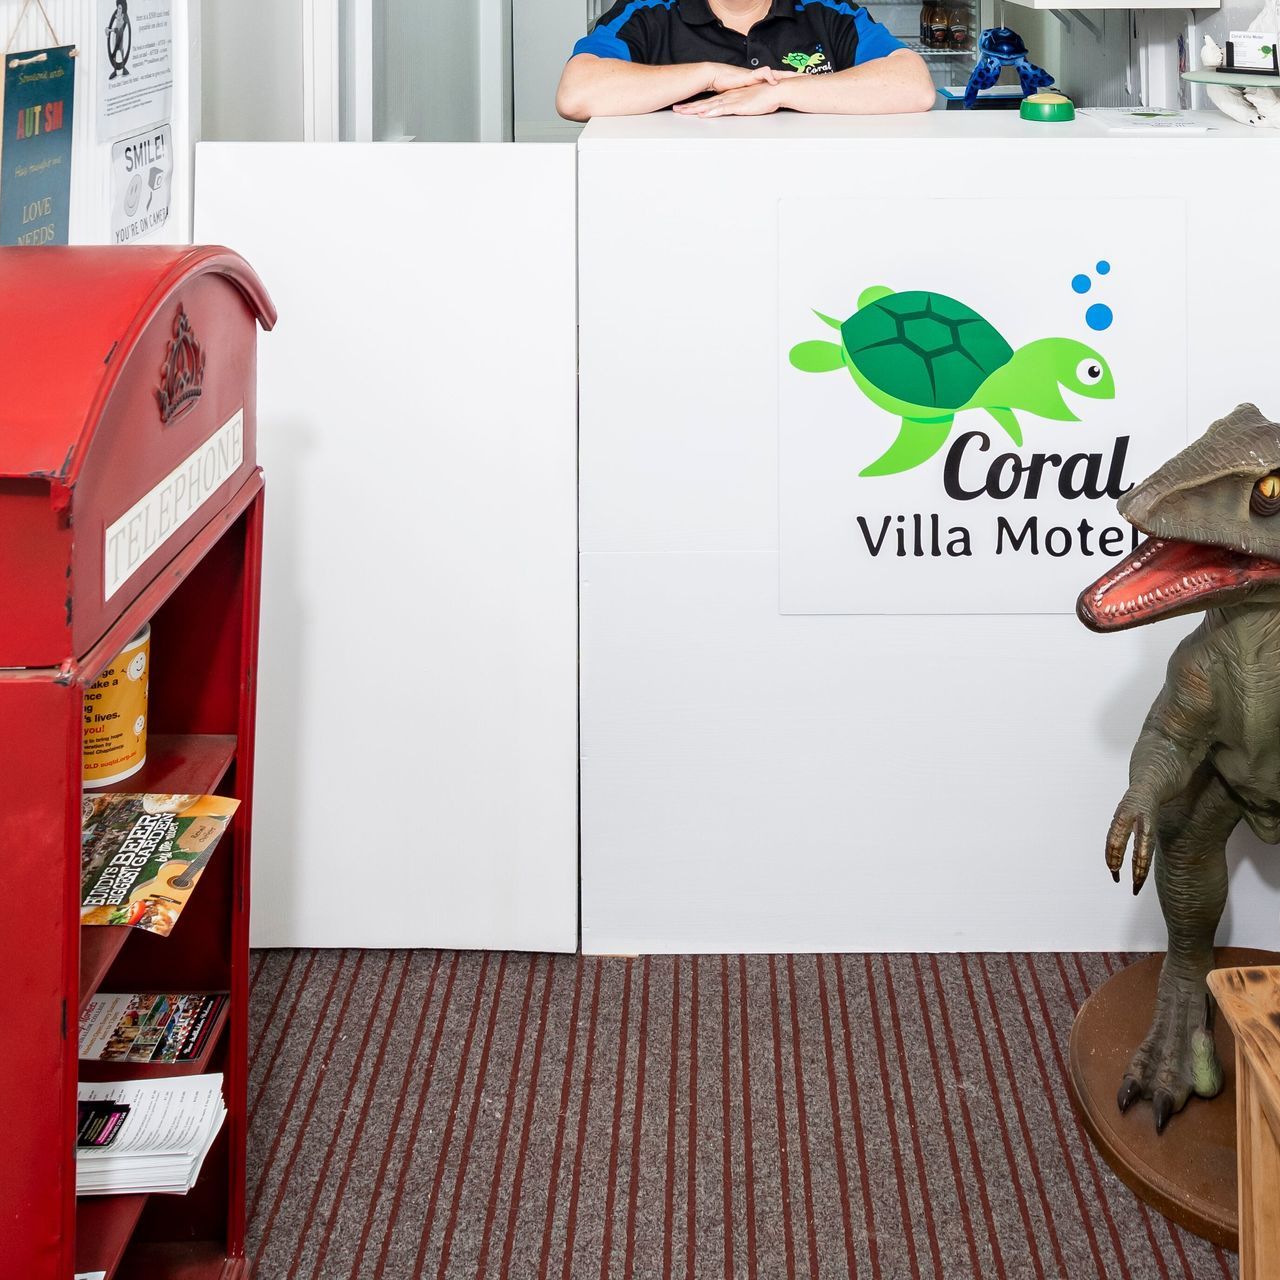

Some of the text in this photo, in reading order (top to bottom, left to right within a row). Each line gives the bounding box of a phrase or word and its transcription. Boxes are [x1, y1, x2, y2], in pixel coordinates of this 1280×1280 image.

[805, 61, 832, 74] Coral
[124, 133, 165, 173] SMILE!
[22, 196, 53, 225] LOVE
[16, 223, 55, 246] NEEDS
[115, 221, 140, 244] YOU'RE
[140, 218, 149, 232] ON
[943, 430, 1135, 501] Coral
[107, 419, 242, 586] TELEPHONE
[856, 513, 1142, 558] Villa Motel
[83, 724, 106, 736] you!
[94, 712, 121, 724] lives.
[110, 812, 163, 866] BEER
[131, 811, 178, 871] GARDEN
